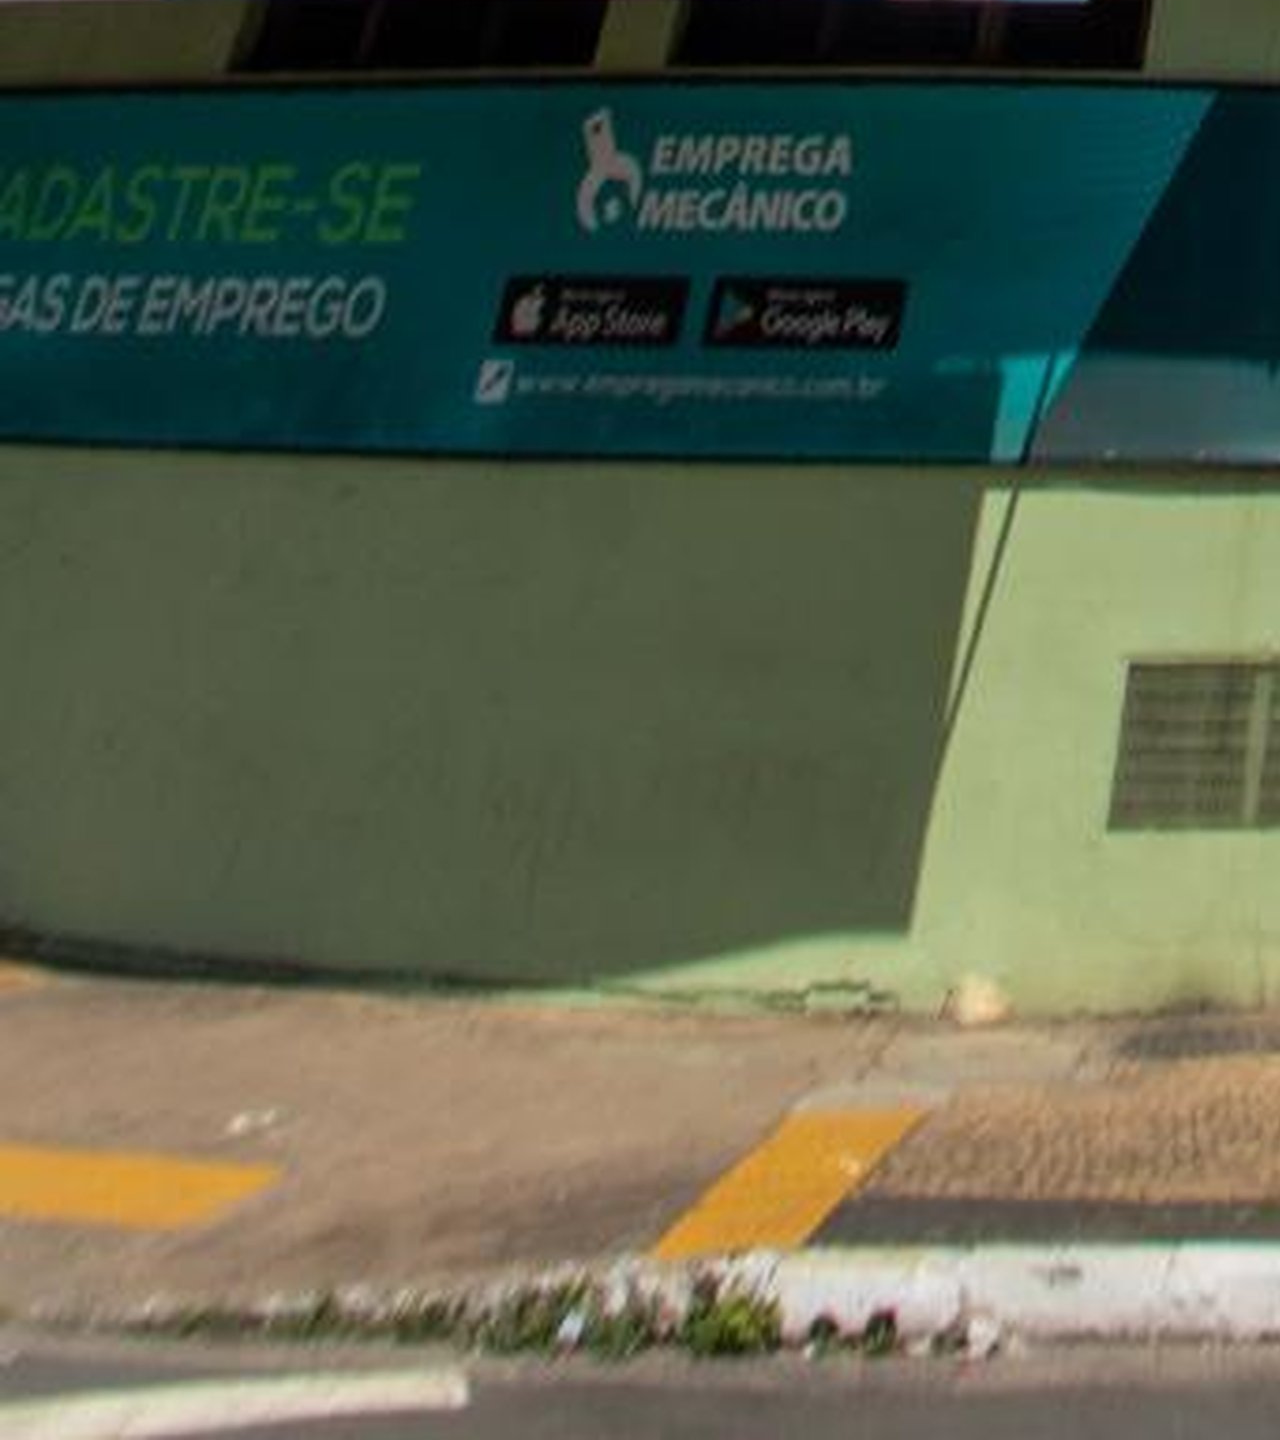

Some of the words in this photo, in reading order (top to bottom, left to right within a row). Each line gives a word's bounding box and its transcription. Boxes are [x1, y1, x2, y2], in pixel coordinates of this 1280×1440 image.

[652, 135, 853, 176] EMPREGA
[638, 181, 846, 229] MECÂNICO
[71, 277, 141, 332] DE
[138, 277, 387, 336] EMPREGO
[550, 307, 599, 339] App
[604, 306, 668, 335] Store
[760, 307, 839, 340] Google
[843, 307, 890, 341] Play
